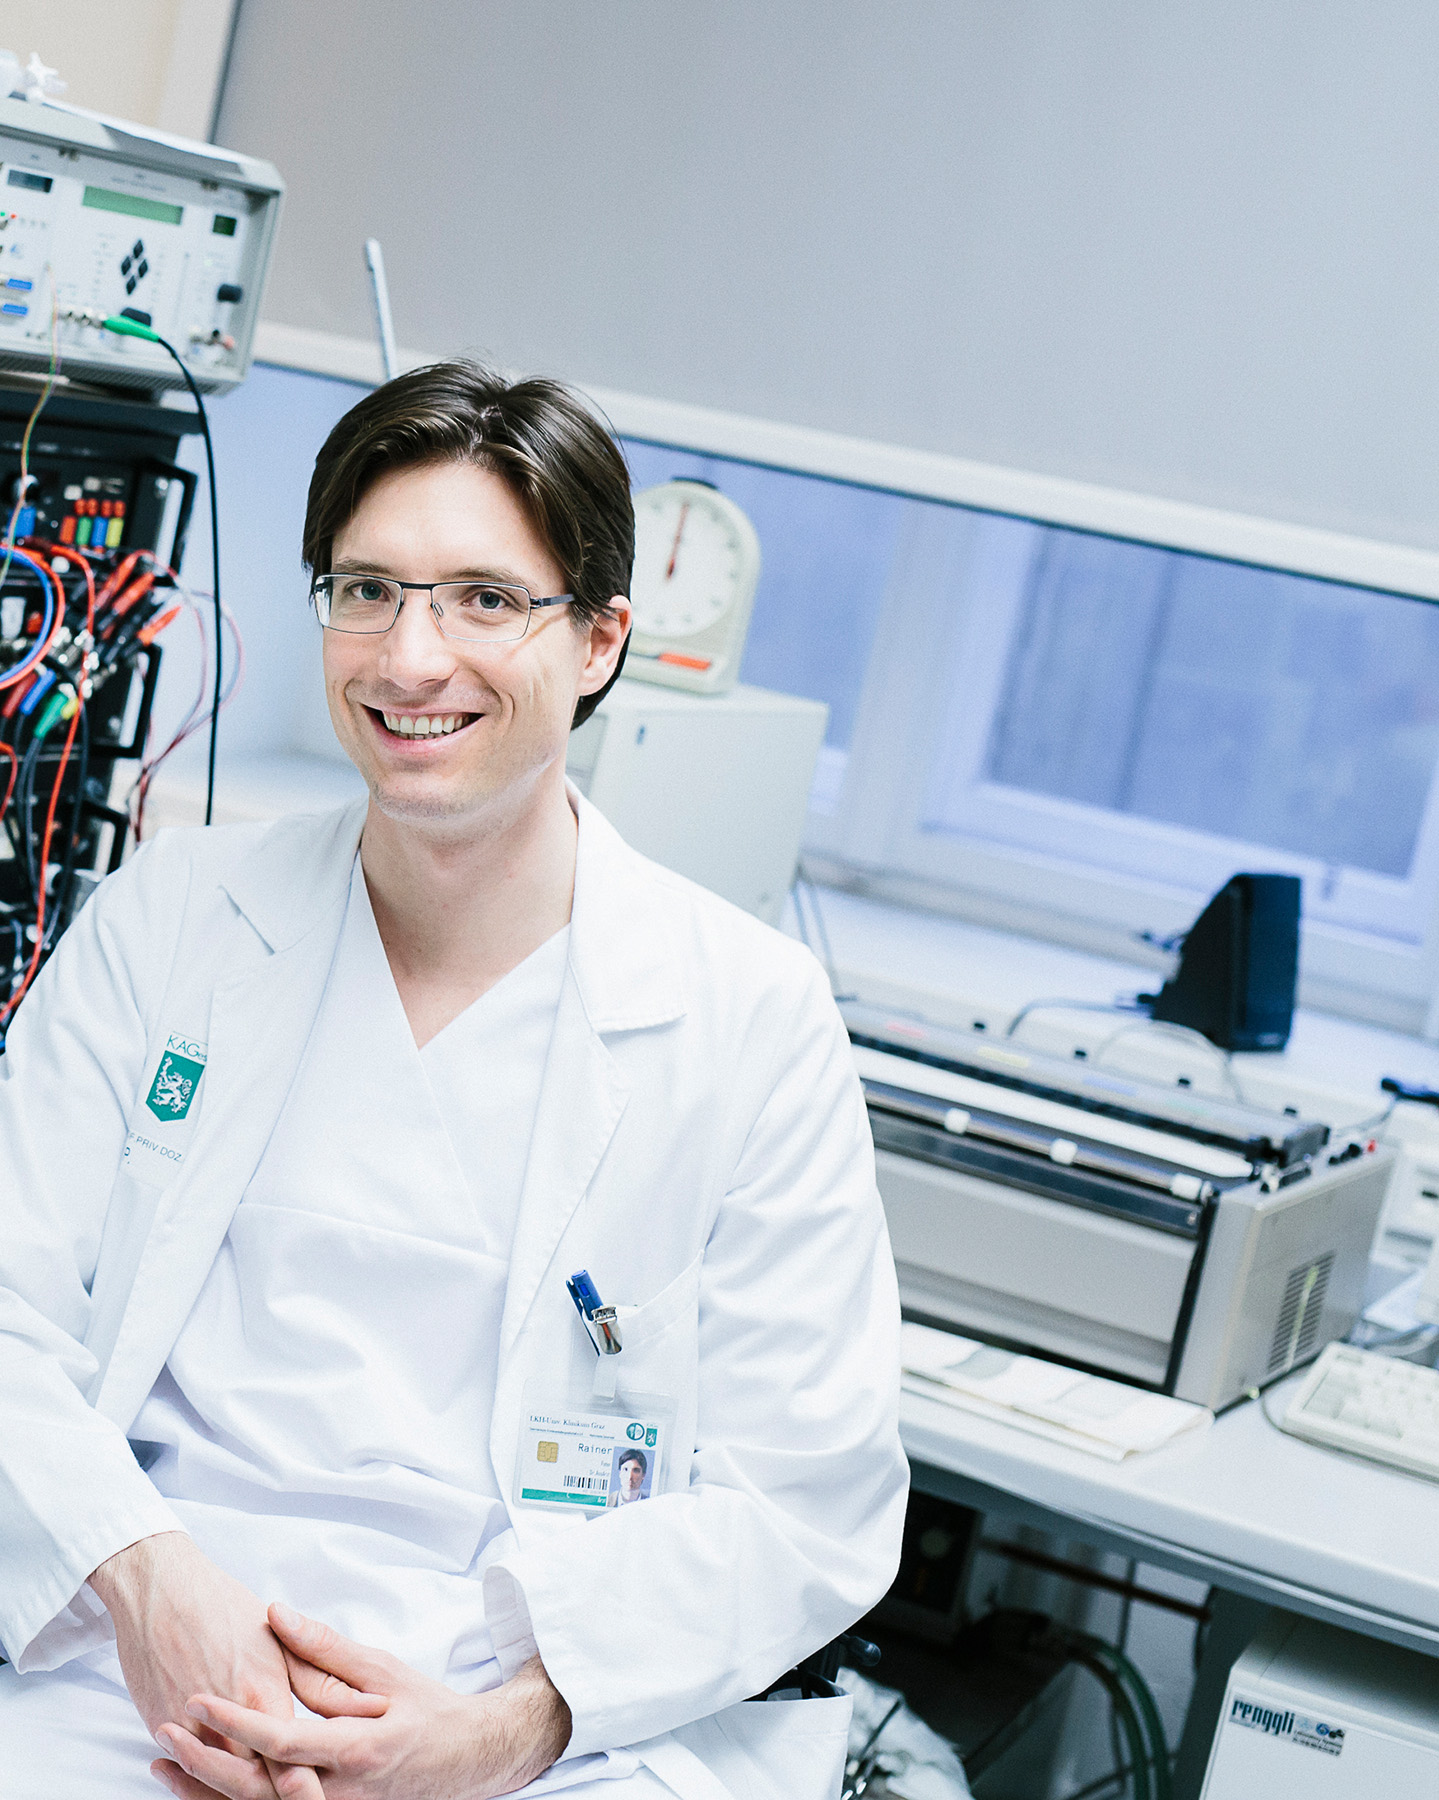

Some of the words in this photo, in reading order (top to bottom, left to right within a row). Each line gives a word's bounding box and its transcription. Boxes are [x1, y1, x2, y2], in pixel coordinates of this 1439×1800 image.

[136, 1135, 159, 1151] PRIV
[577, 1443, 613, 1455] Rainer
[1231, 1700, 1296, 1736] renggli
